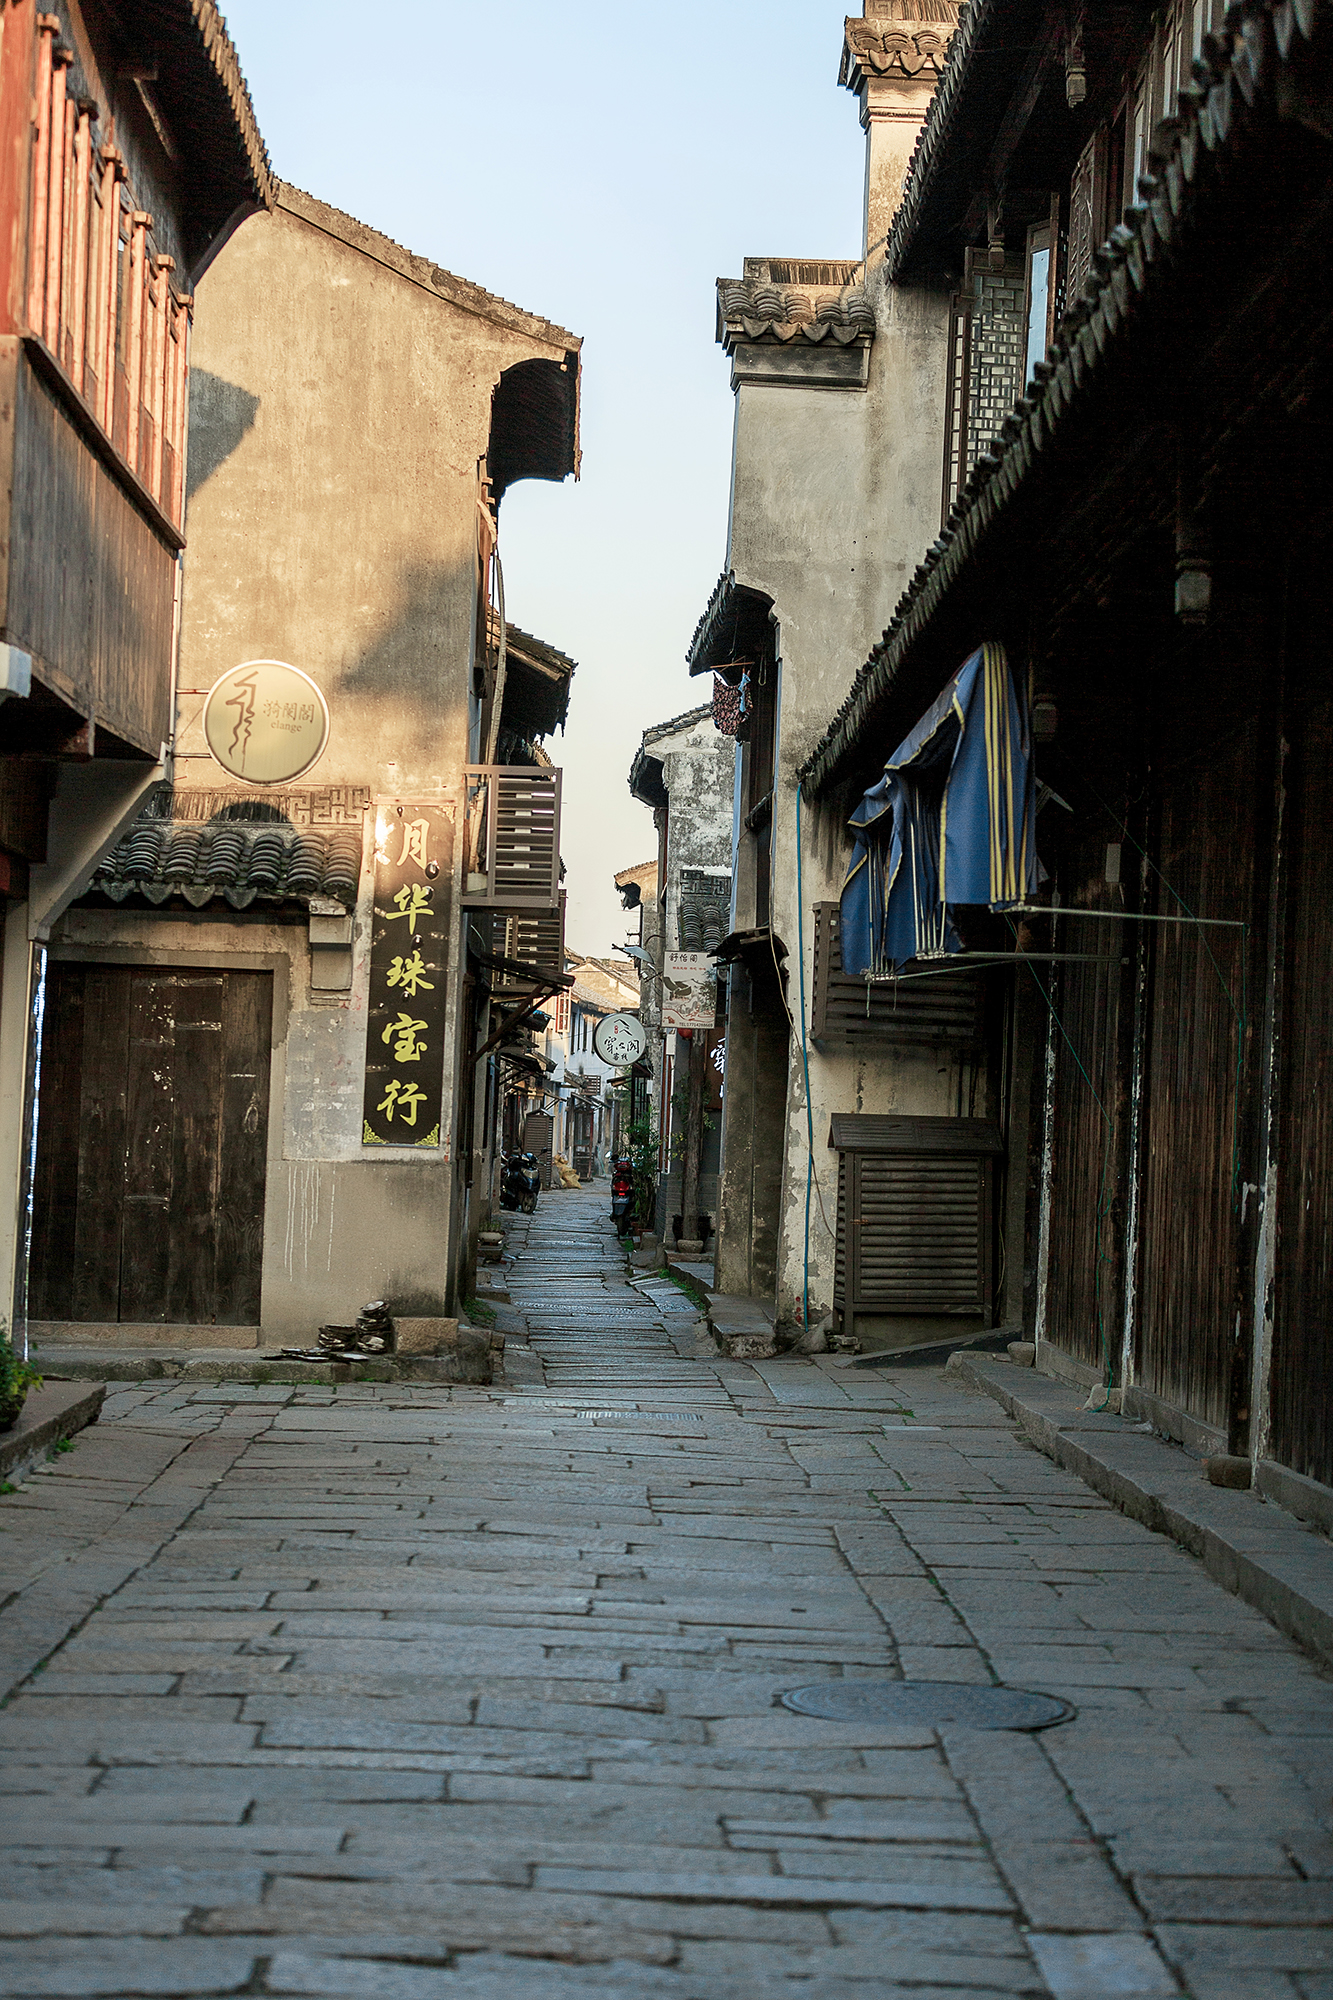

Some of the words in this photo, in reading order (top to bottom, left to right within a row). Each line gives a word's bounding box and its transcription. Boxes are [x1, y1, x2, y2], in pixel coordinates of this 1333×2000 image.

[376, 818, 435, 1127] 月华珠宝行
